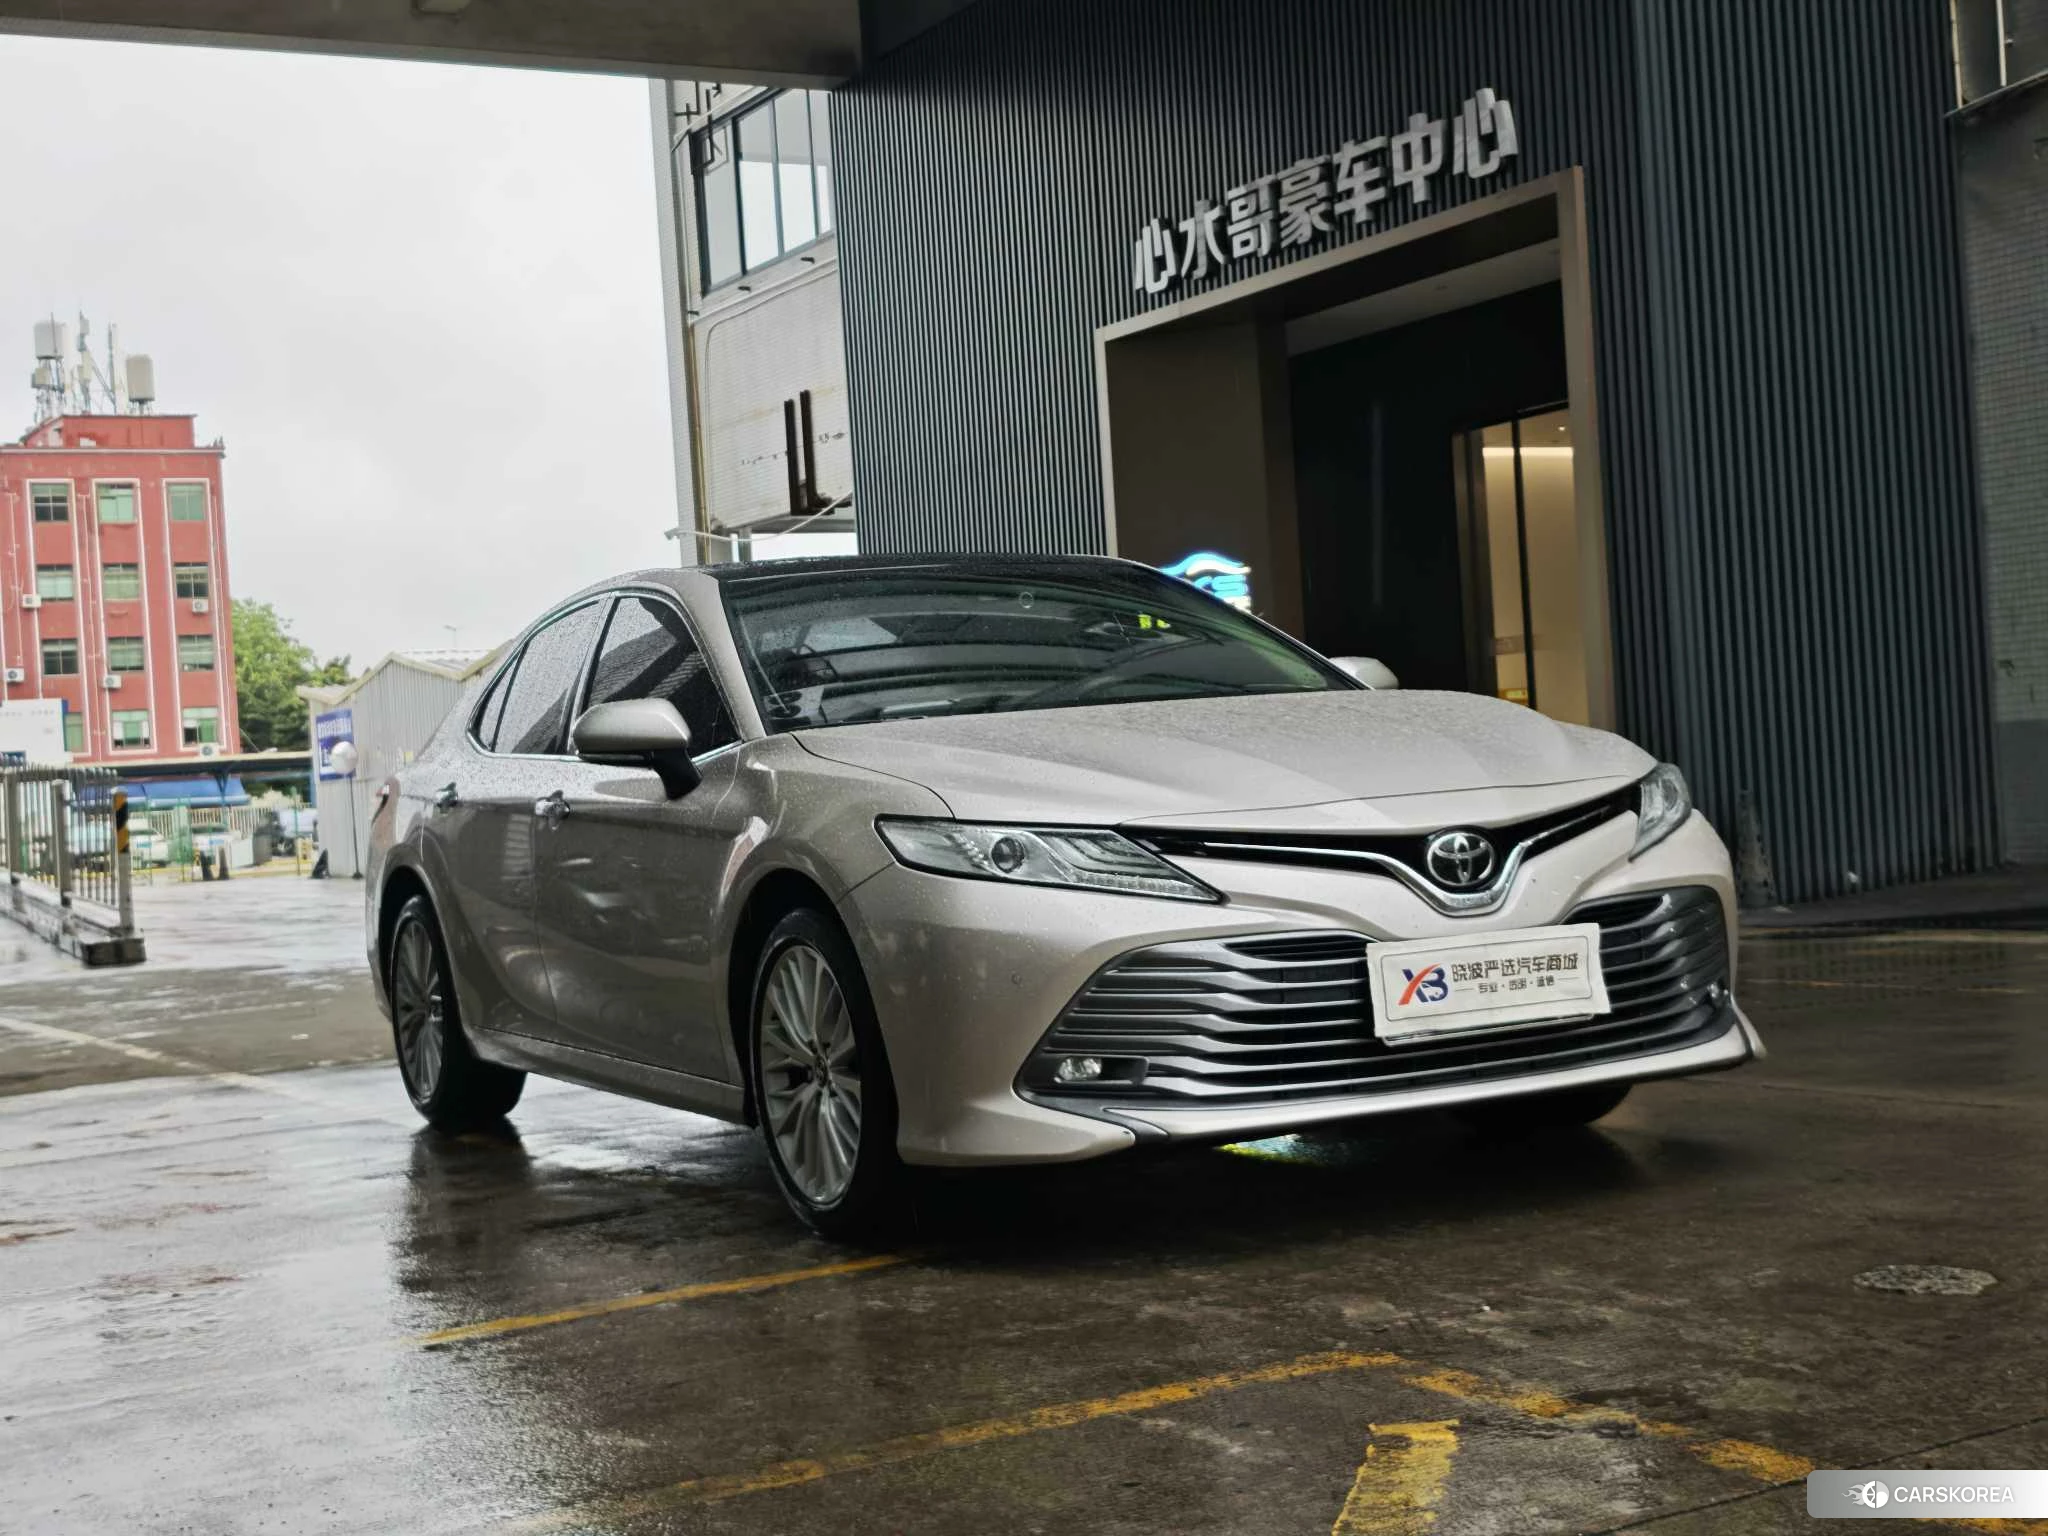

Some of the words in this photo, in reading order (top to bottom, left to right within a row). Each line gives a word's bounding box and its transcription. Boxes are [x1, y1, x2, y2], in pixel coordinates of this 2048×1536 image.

[1135, 87, 1519, 294] 心水哥豪车中心
